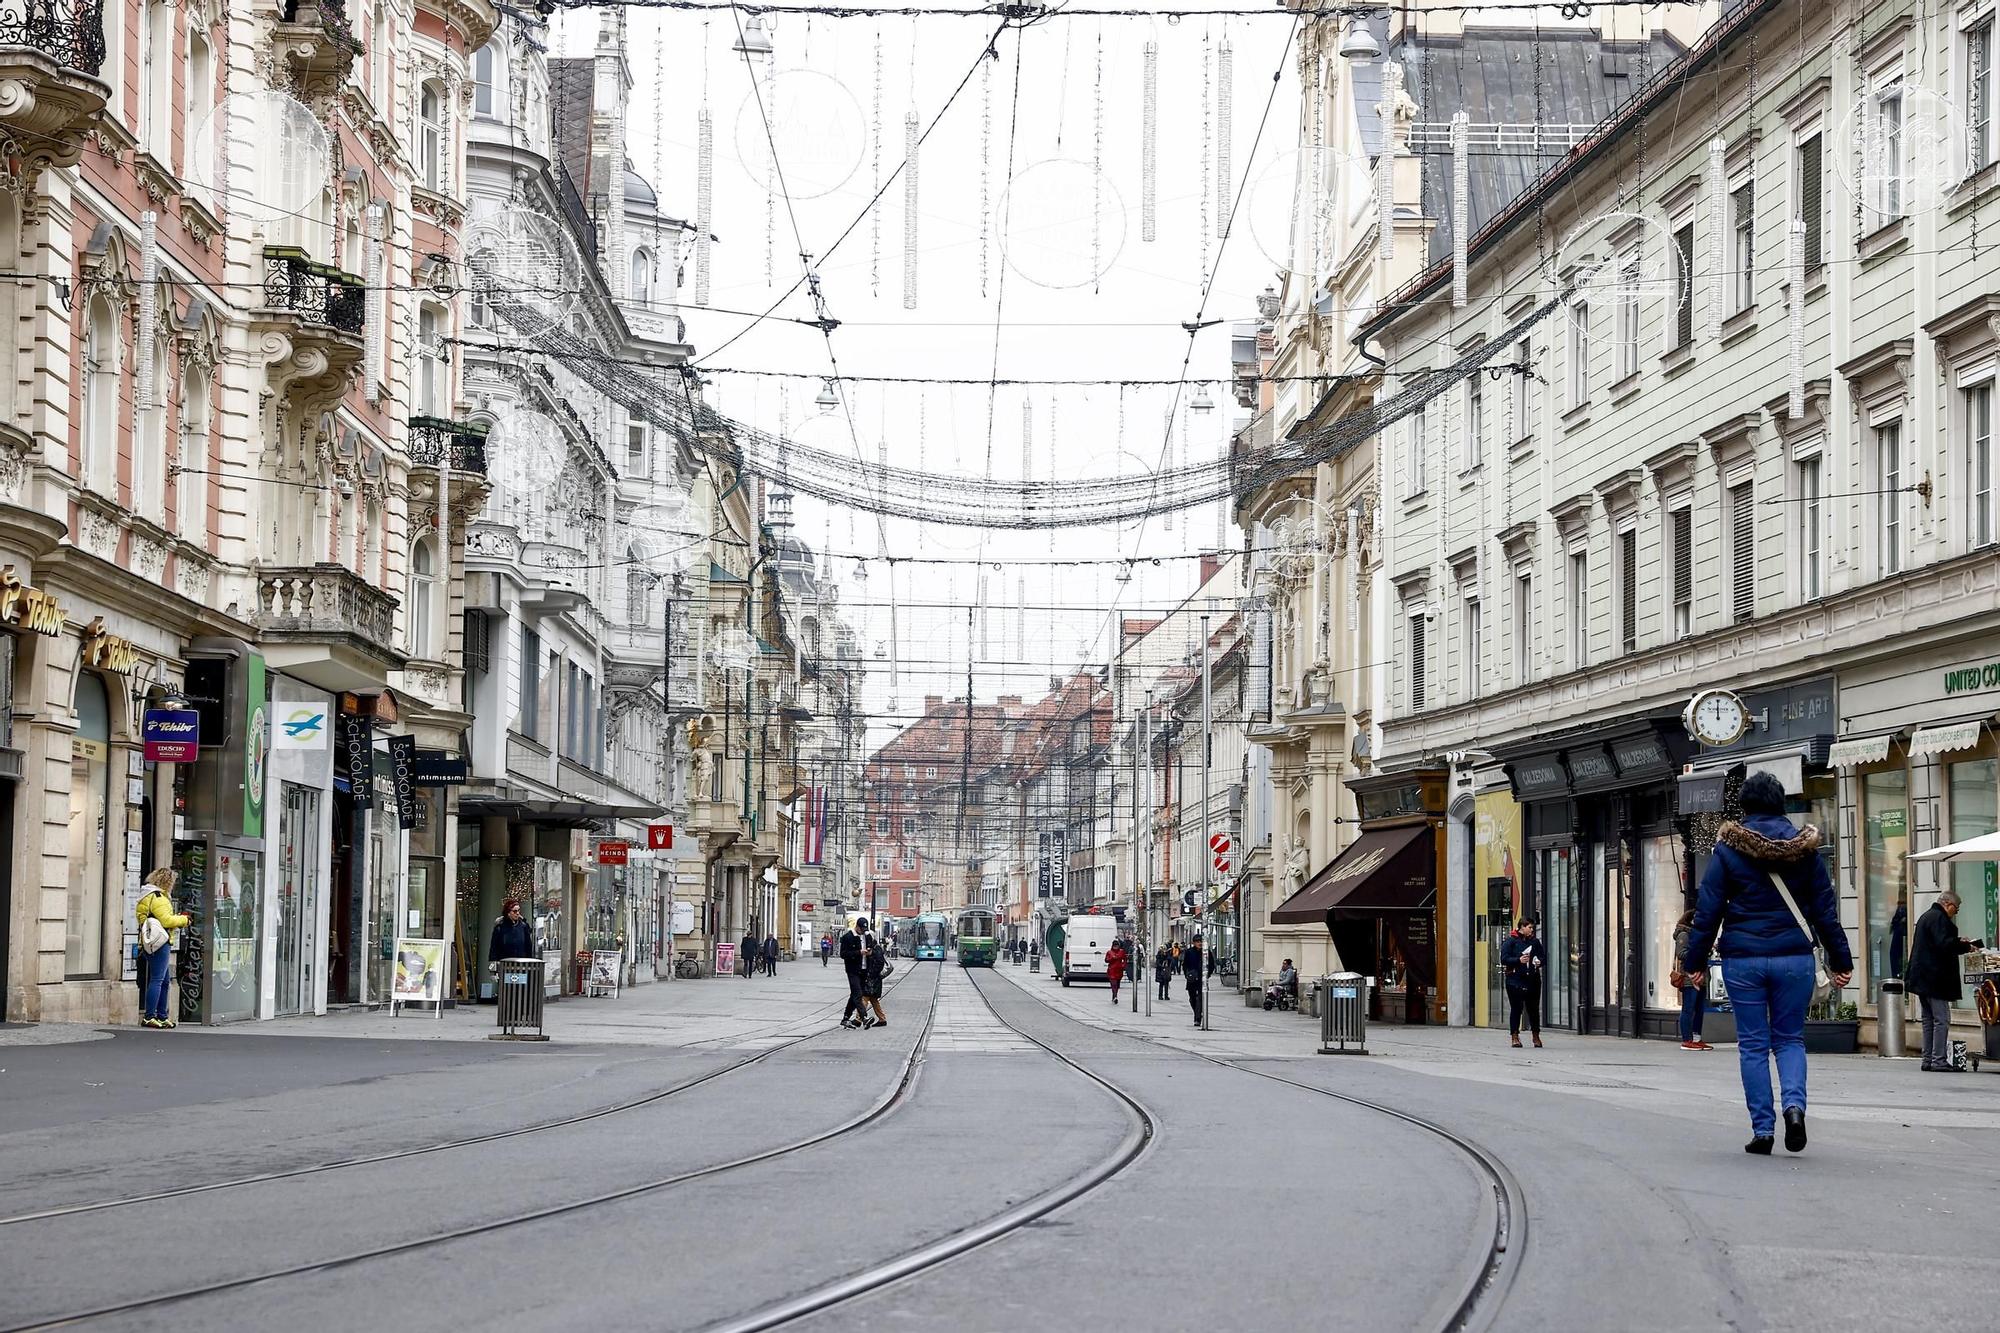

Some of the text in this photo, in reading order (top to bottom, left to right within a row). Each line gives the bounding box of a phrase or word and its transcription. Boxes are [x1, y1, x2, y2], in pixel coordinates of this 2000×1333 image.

[26, 593, 67, 635] Tchibo
[107, 641, 140, 675] Tchibo
[1945, 664, 2000, 693] UNITED CO
[1808, 696, 1829, 719] ART
[159, 722, 196, 732] Tchibo
[347, 716, 365, 801] SCHOKOLADE
[393, 743, 413, 821] SCHOKOLADE
[418, 774, 464, 782] intimissimi
[186, 845, 204, 914] Italiana
[1054, 838, 1063, 888] HUMANIC
